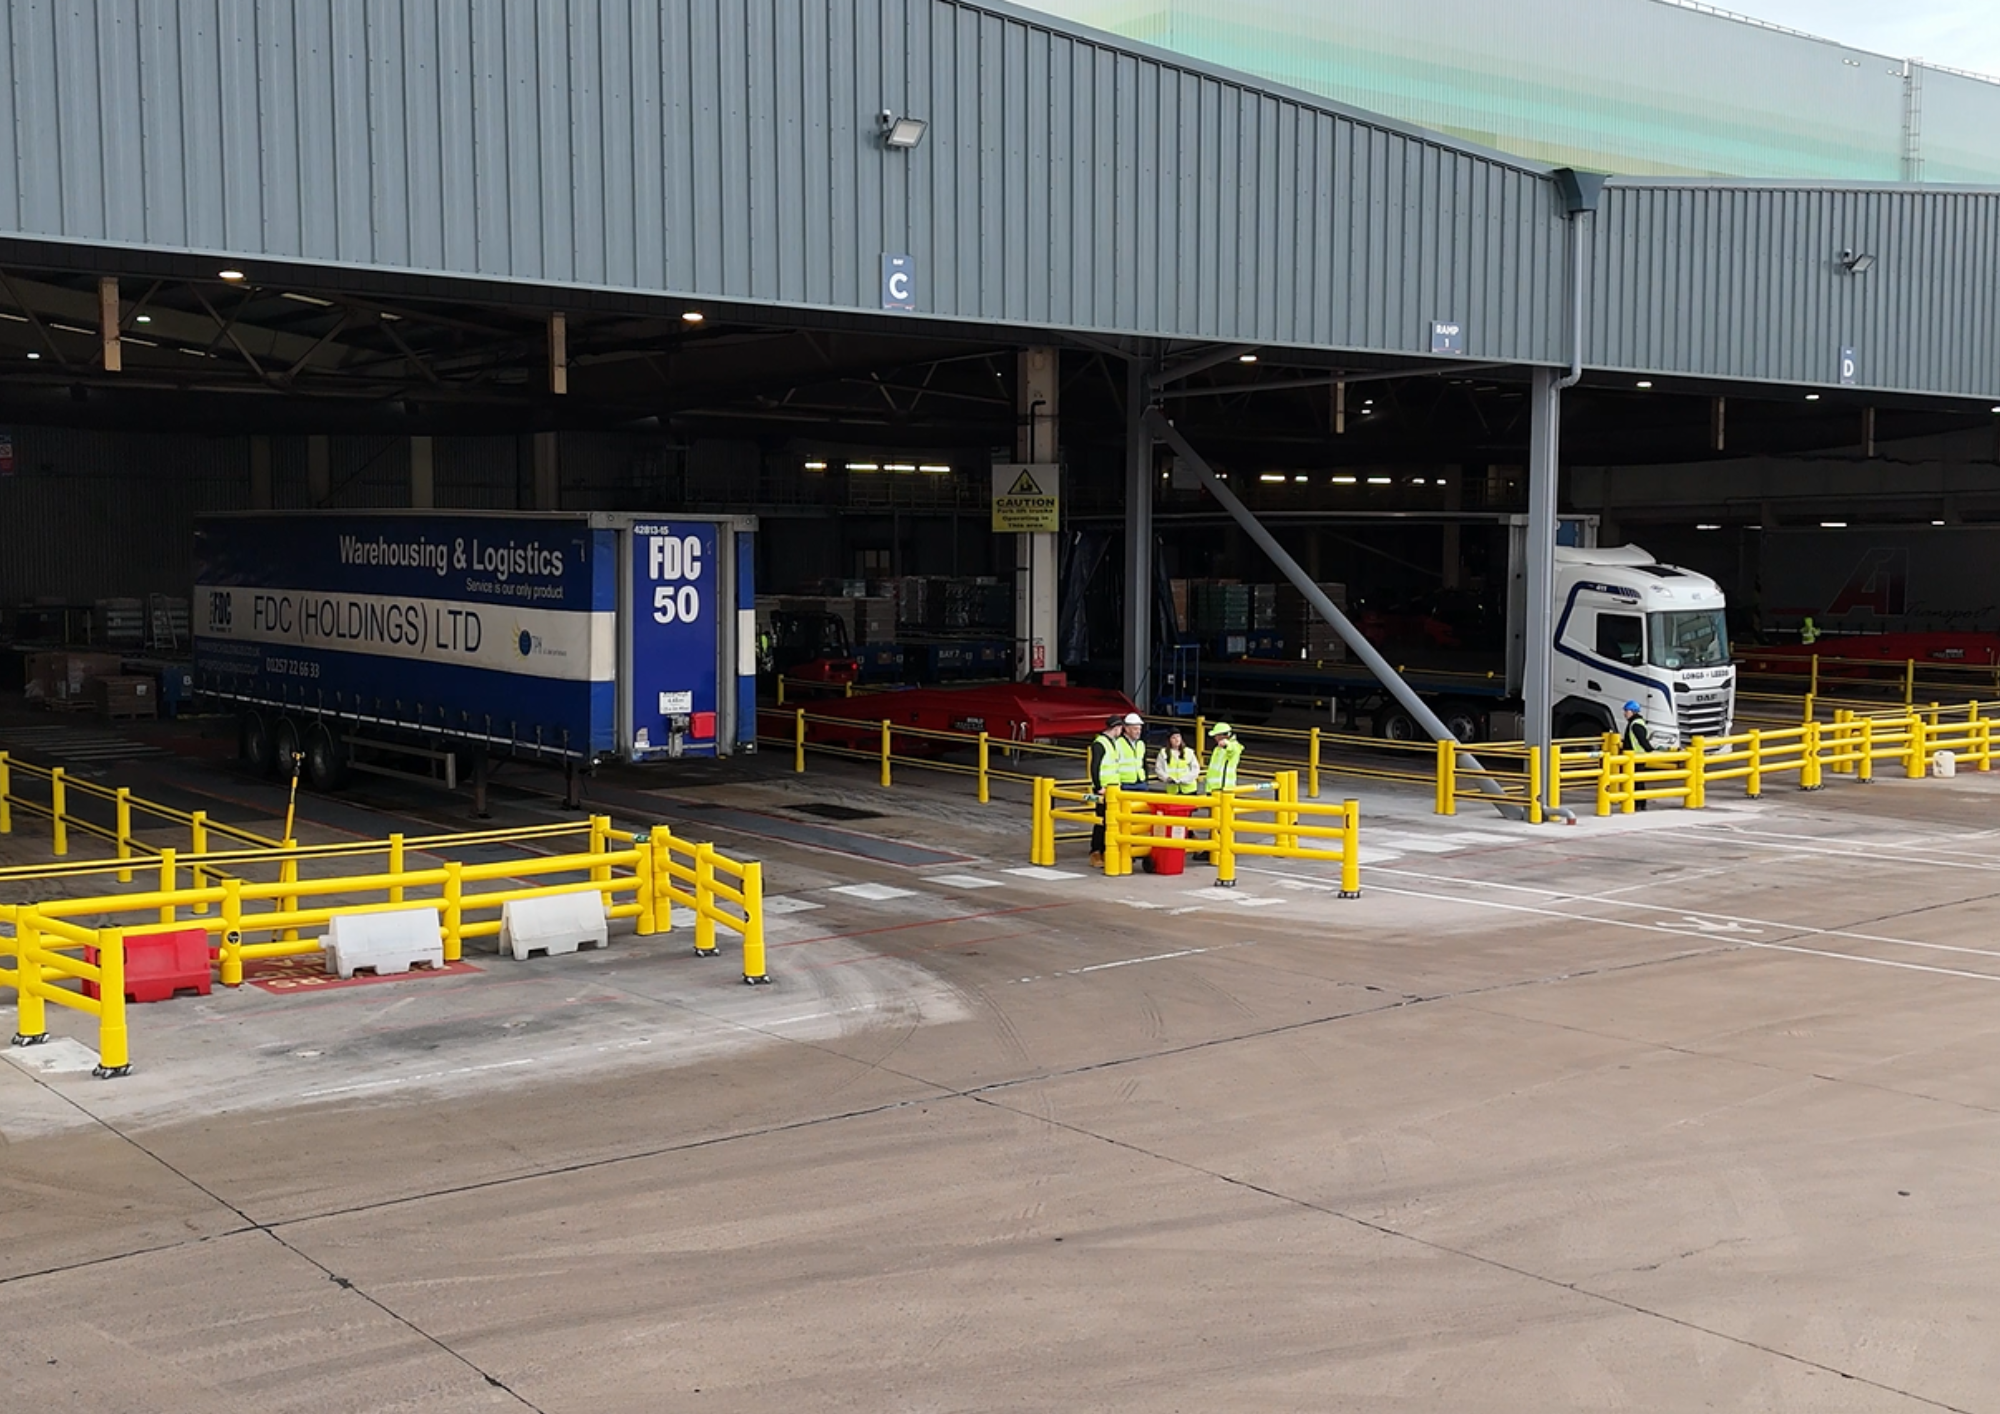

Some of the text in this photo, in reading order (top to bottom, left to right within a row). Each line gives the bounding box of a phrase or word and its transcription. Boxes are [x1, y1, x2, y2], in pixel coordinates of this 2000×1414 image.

[889, 272, 909, 300] C
[1436, 324, 1459, 336] RAMP
[1445, 338, 1450, 348] 1
[1843, 359, 1854, 377] D
[996, 498, 1055, 507] CAUTION
[339, 534, 564, 581] Warehousing & Logistics
[649, 535, 702, 580] FDC
[465, 577, 564, 600] Service is our only product
[212, 592, 232, 625] FDC
[653, 585, 700, 624] 50
[254, 596, 292, 633] FDC
[299, 596, 428, 653] (HOLDINGS)
[436, 608, 482, 652] LTD
[939, 649, 960, 659] BAY 7
[265, 656, 287, 673] 01257
[288, 659, 298, 675] 22
[299, 660, 309, 677] 66
[309, 661, 320, 678] 33
[1710, 669, 1729, 679] LEEDS
[1696, 693, 1718, 702] DAF
